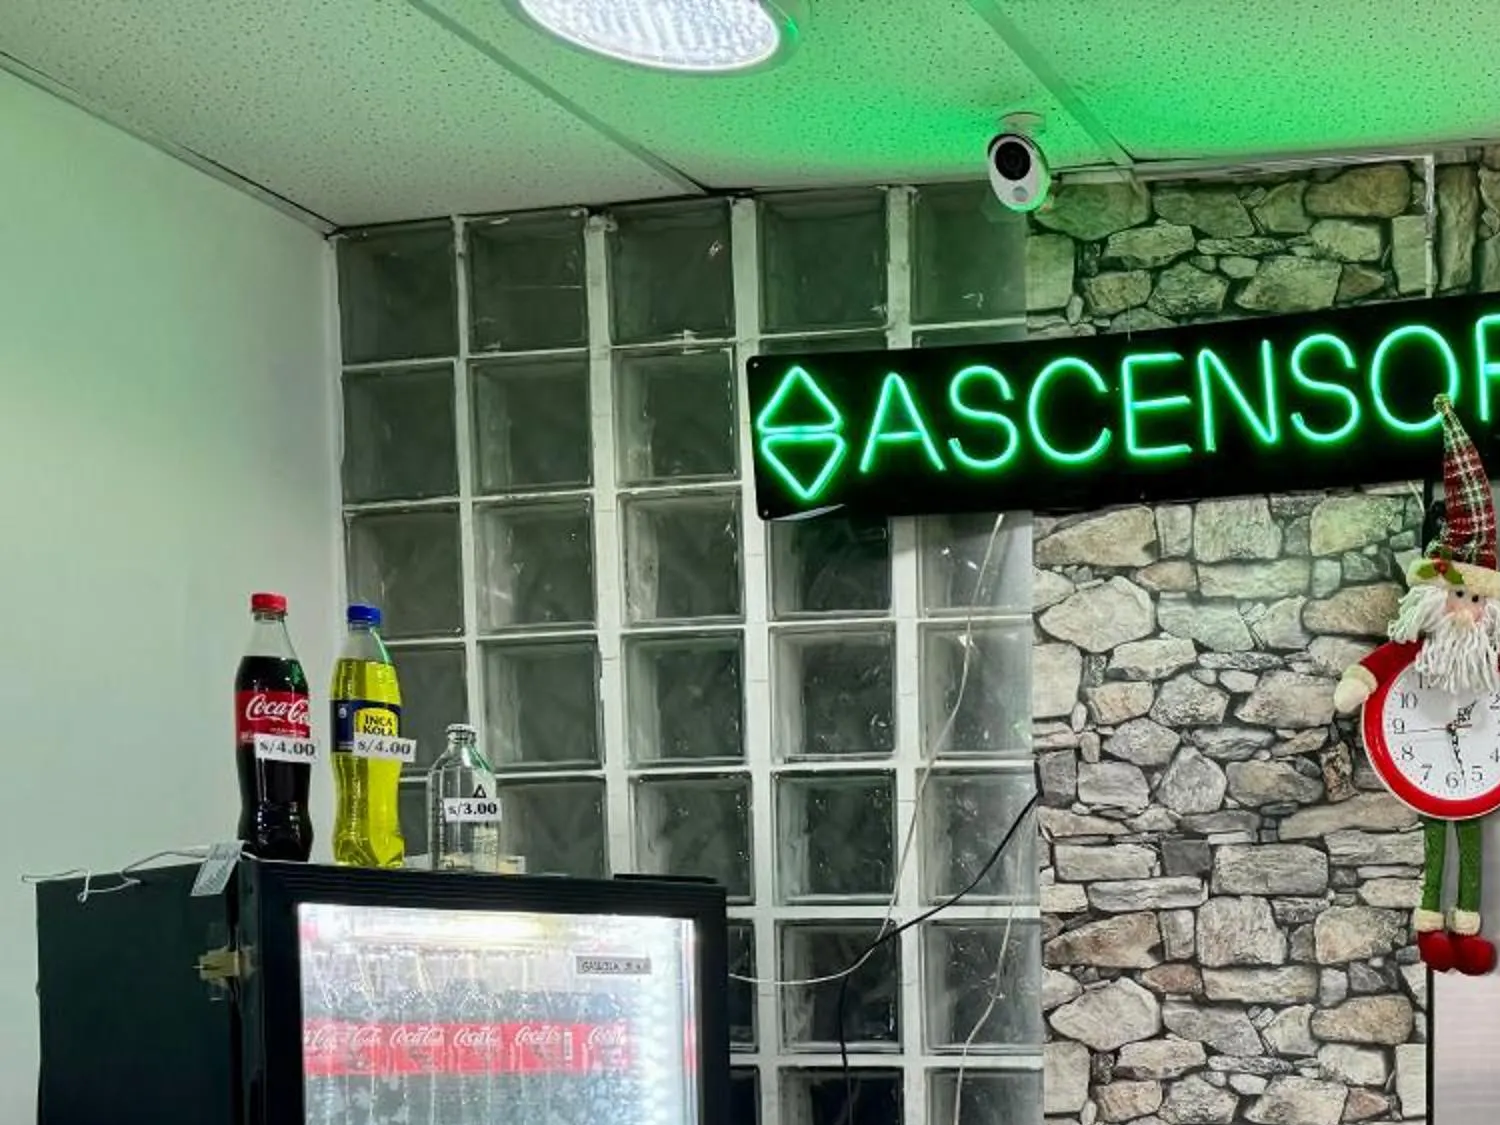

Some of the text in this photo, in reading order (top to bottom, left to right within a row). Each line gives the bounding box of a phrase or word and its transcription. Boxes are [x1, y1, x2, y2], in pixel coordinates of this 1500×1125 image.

[1401, 692, 1418, 709] 10
[246, 693, 312, 725] Coca-Co
[365, 713, 393, 727] INCA
[1393, 719, 1405, 734] 9
[1402, 745, 1415, 761] 8
[1490, 747, 1500, 763] 4
[1421, 765, 1432, 781] 7
[1446, 772, 1459, 788] 6
[1472, 765, 1483, 782] 5
